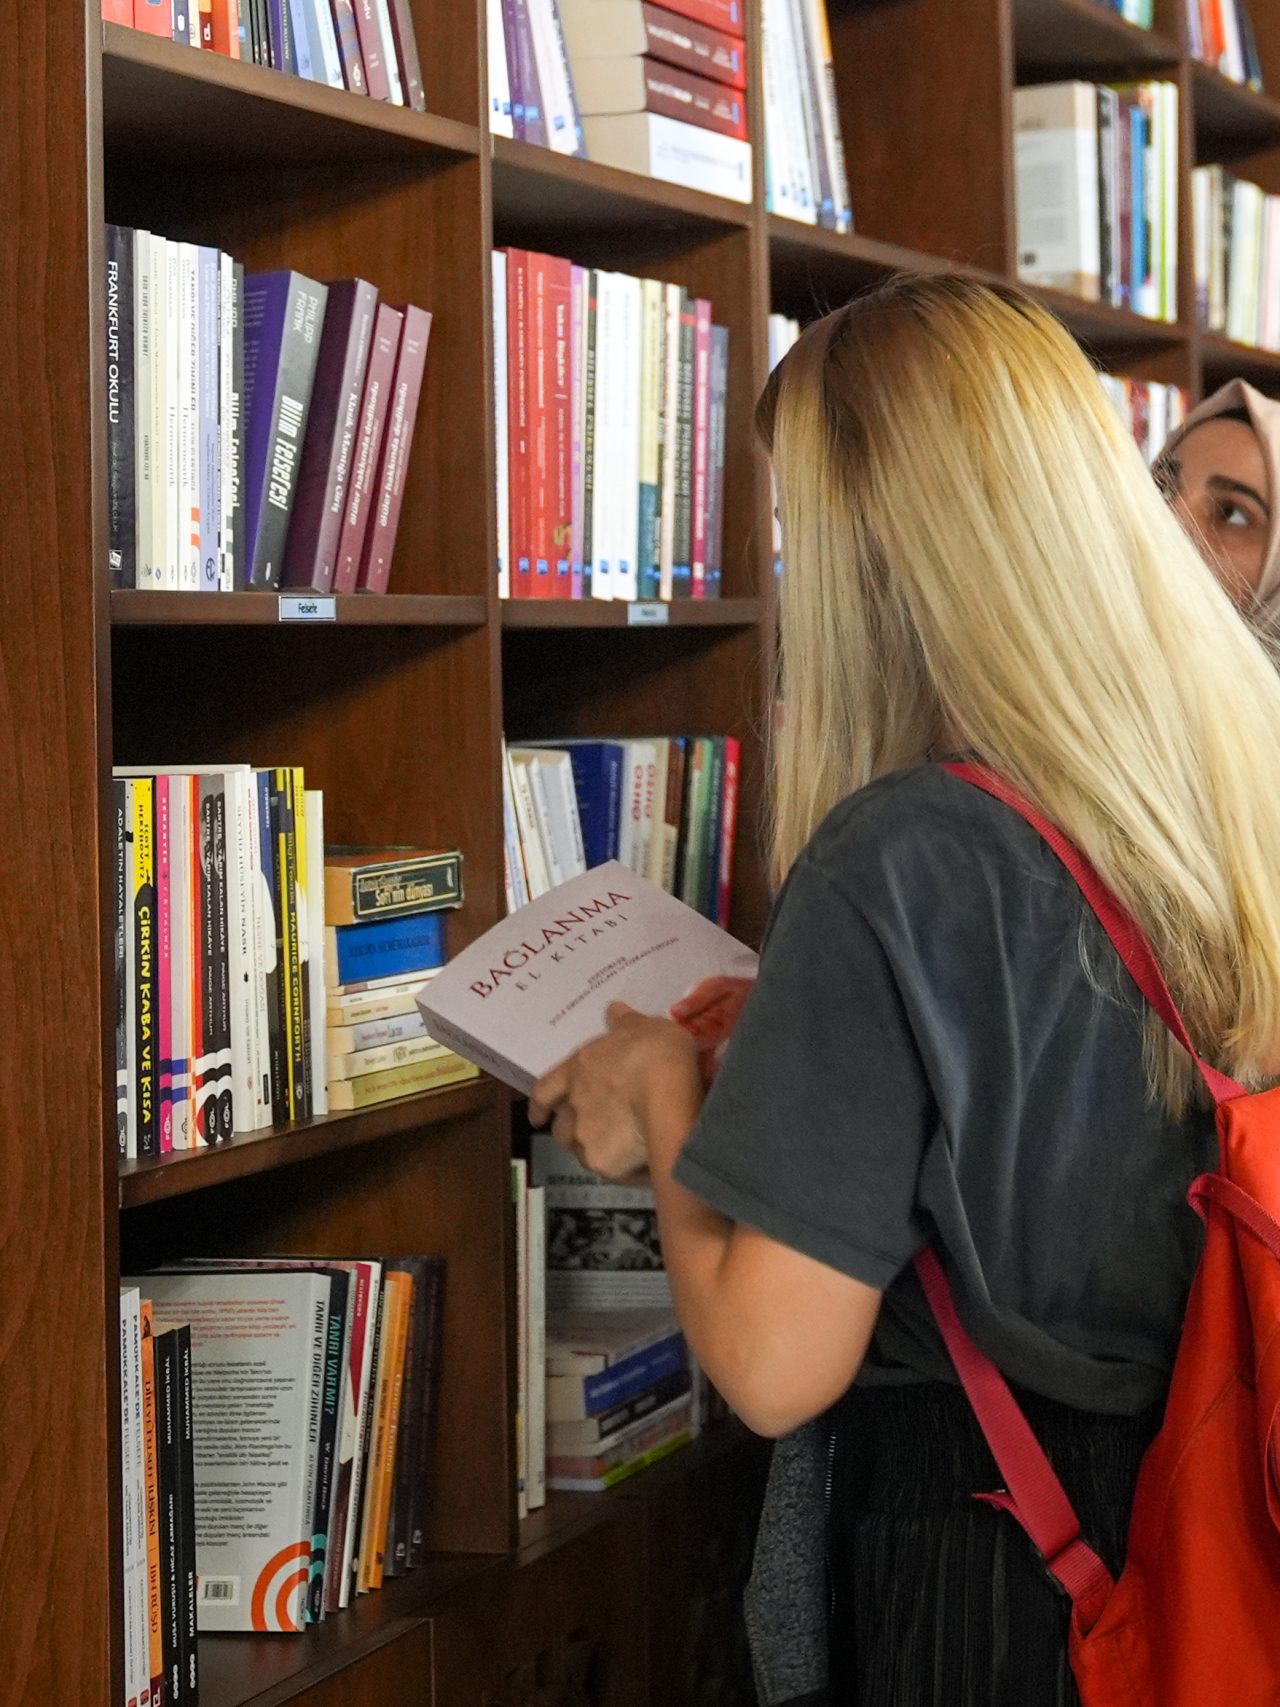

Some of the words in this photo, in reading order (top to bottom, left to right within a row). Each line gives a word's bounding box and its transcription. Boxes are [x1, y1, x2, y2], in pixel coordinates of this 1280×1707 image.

[108, 261, 119, 361] FRANKFURT
[293, 290, 308, 333] FRANK
[304, 295, 318, 344] PHILIPP
[108, 364, 119, 423] OKULU
[345, 393, 359, 427] Klasik
[278, 395, 304, 438] Bilim
[268, 438, 297, 511] Felsefesi
[138, 906, 151, 977] ÇİRKİN
[290, 911, 299, 973] MAURICE
[469, 891, 632, 999] BAĞLANMA
[515, 971, 542, 992] EL
[140, 982, 151, 1040] KABA
[293, 977, 302, 1062] CORNFORTH
[141, 1045, 151, 1071] VE
[140, 1076, 152, 1124] KISA
[315, 1300, 325, 1333] TANRI
[328, 1314, 342, 1354] TANRI
[314, 1336, 322, 1350] VE
[312, 1353, 323, 1388] DİĞER
[326, 1358, 338, 1386] VAR
[308, 1390, 320, 1443] ZİHİNLER
[171, 1573, 177, 1581] &
